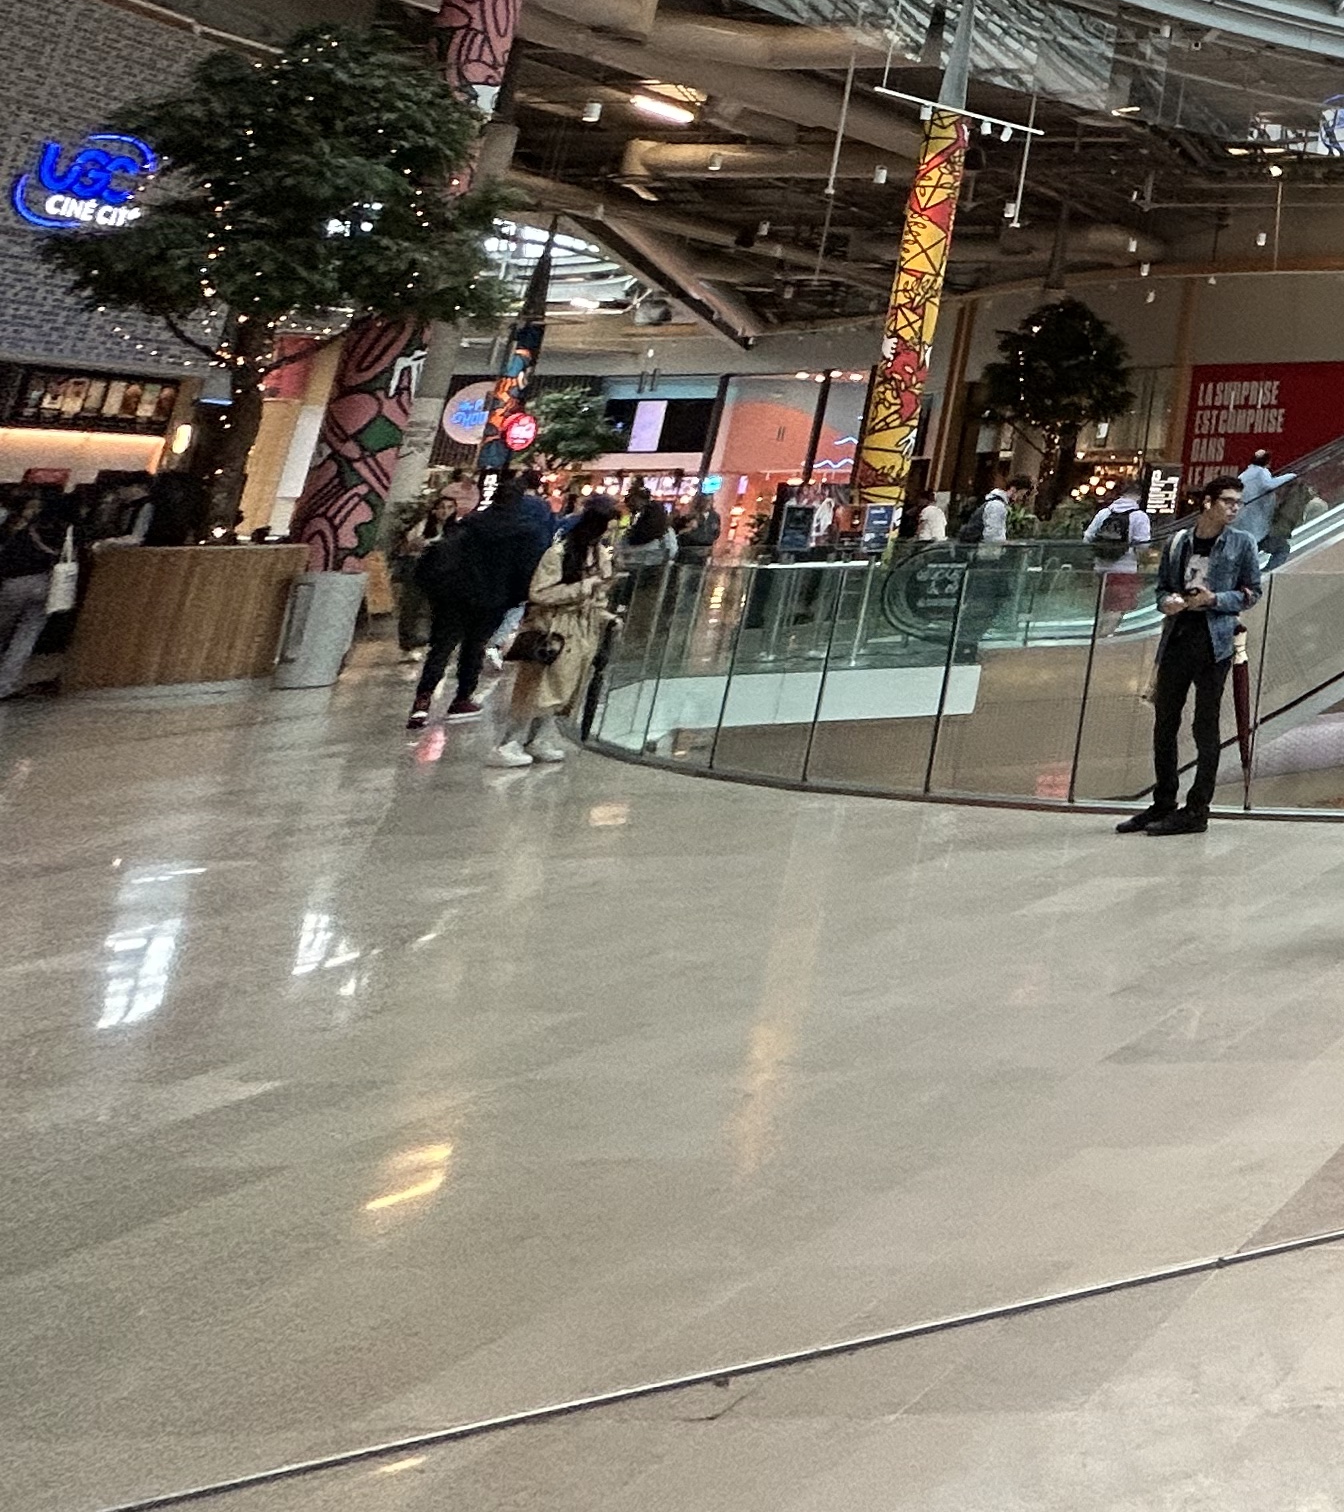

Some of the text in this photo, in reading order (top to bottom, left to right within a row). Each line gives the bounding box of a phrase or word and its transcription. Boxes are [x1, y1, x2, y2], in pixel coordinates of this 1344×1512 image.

[39, 142, 139, 204] UGC
[45, 194, 99, 221] CINÉ
[1198, 380, 1280, 407] LA SURPRISE
[1194, 408, 1285, 435] EST COMPRISE
[1190, 437, 1225, 462] DANS
